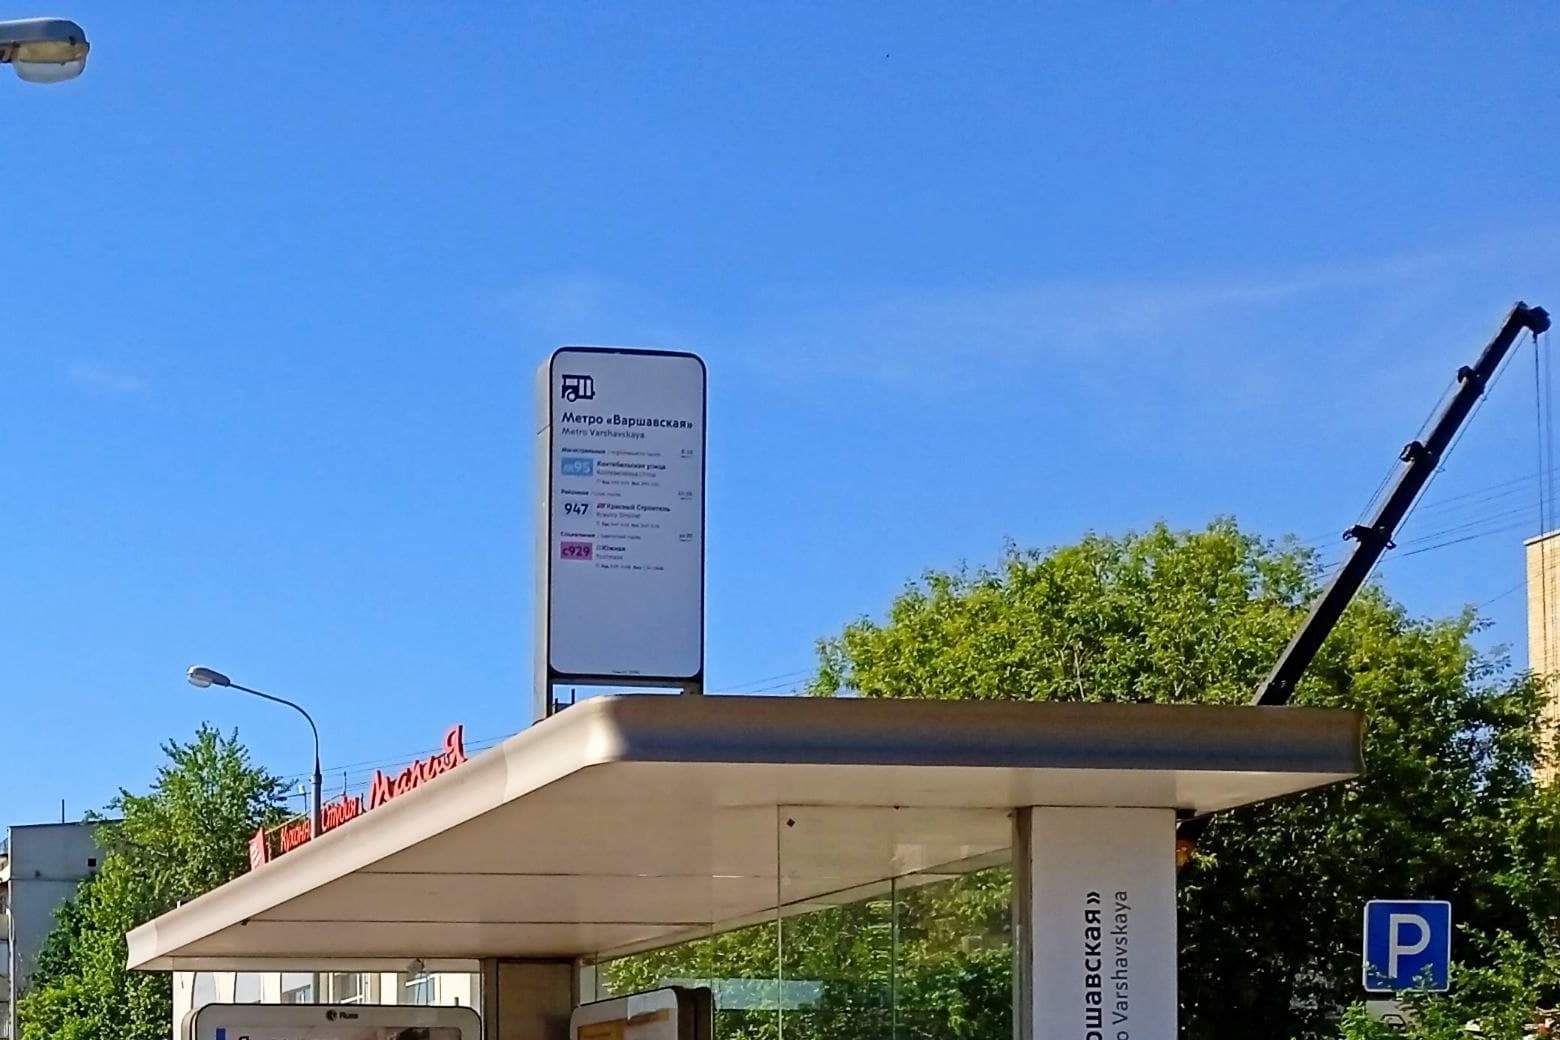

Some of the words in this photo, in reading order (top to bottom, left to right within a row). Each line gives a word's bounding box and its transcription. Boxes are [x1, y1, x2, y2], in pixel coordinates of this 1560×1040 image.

[561, 411, 604, 426] Метро
[606, 414, 693, 429] «Варшавская»
[561, 427, 588, 436] Metro
[589, 428, 645, 439] Varshavskaya
[564, 502, 589, 515] 947
[1388, 913, 1432, 979] P
[1110, 890, 1132, 1025] Varshavskaya
